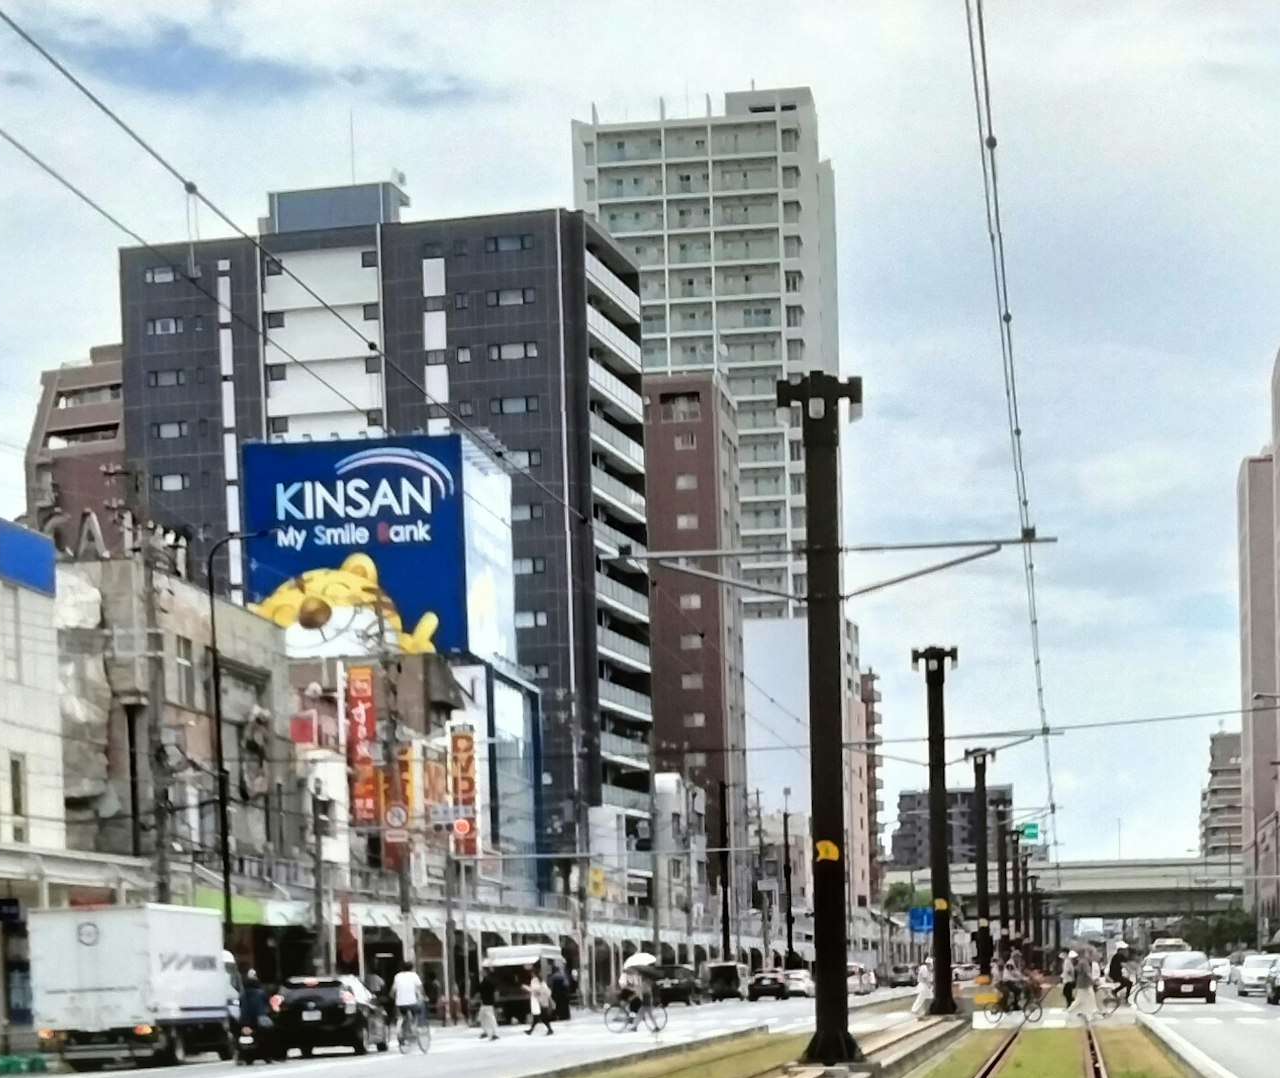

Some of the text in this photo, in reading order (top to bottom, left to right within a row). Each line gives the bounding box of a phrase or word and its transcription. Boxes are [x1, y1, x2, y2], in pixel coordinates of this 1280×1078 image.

[276, 475, 432, 521] KINSAN
[276, 519, 432, 551] My Smile Bank
